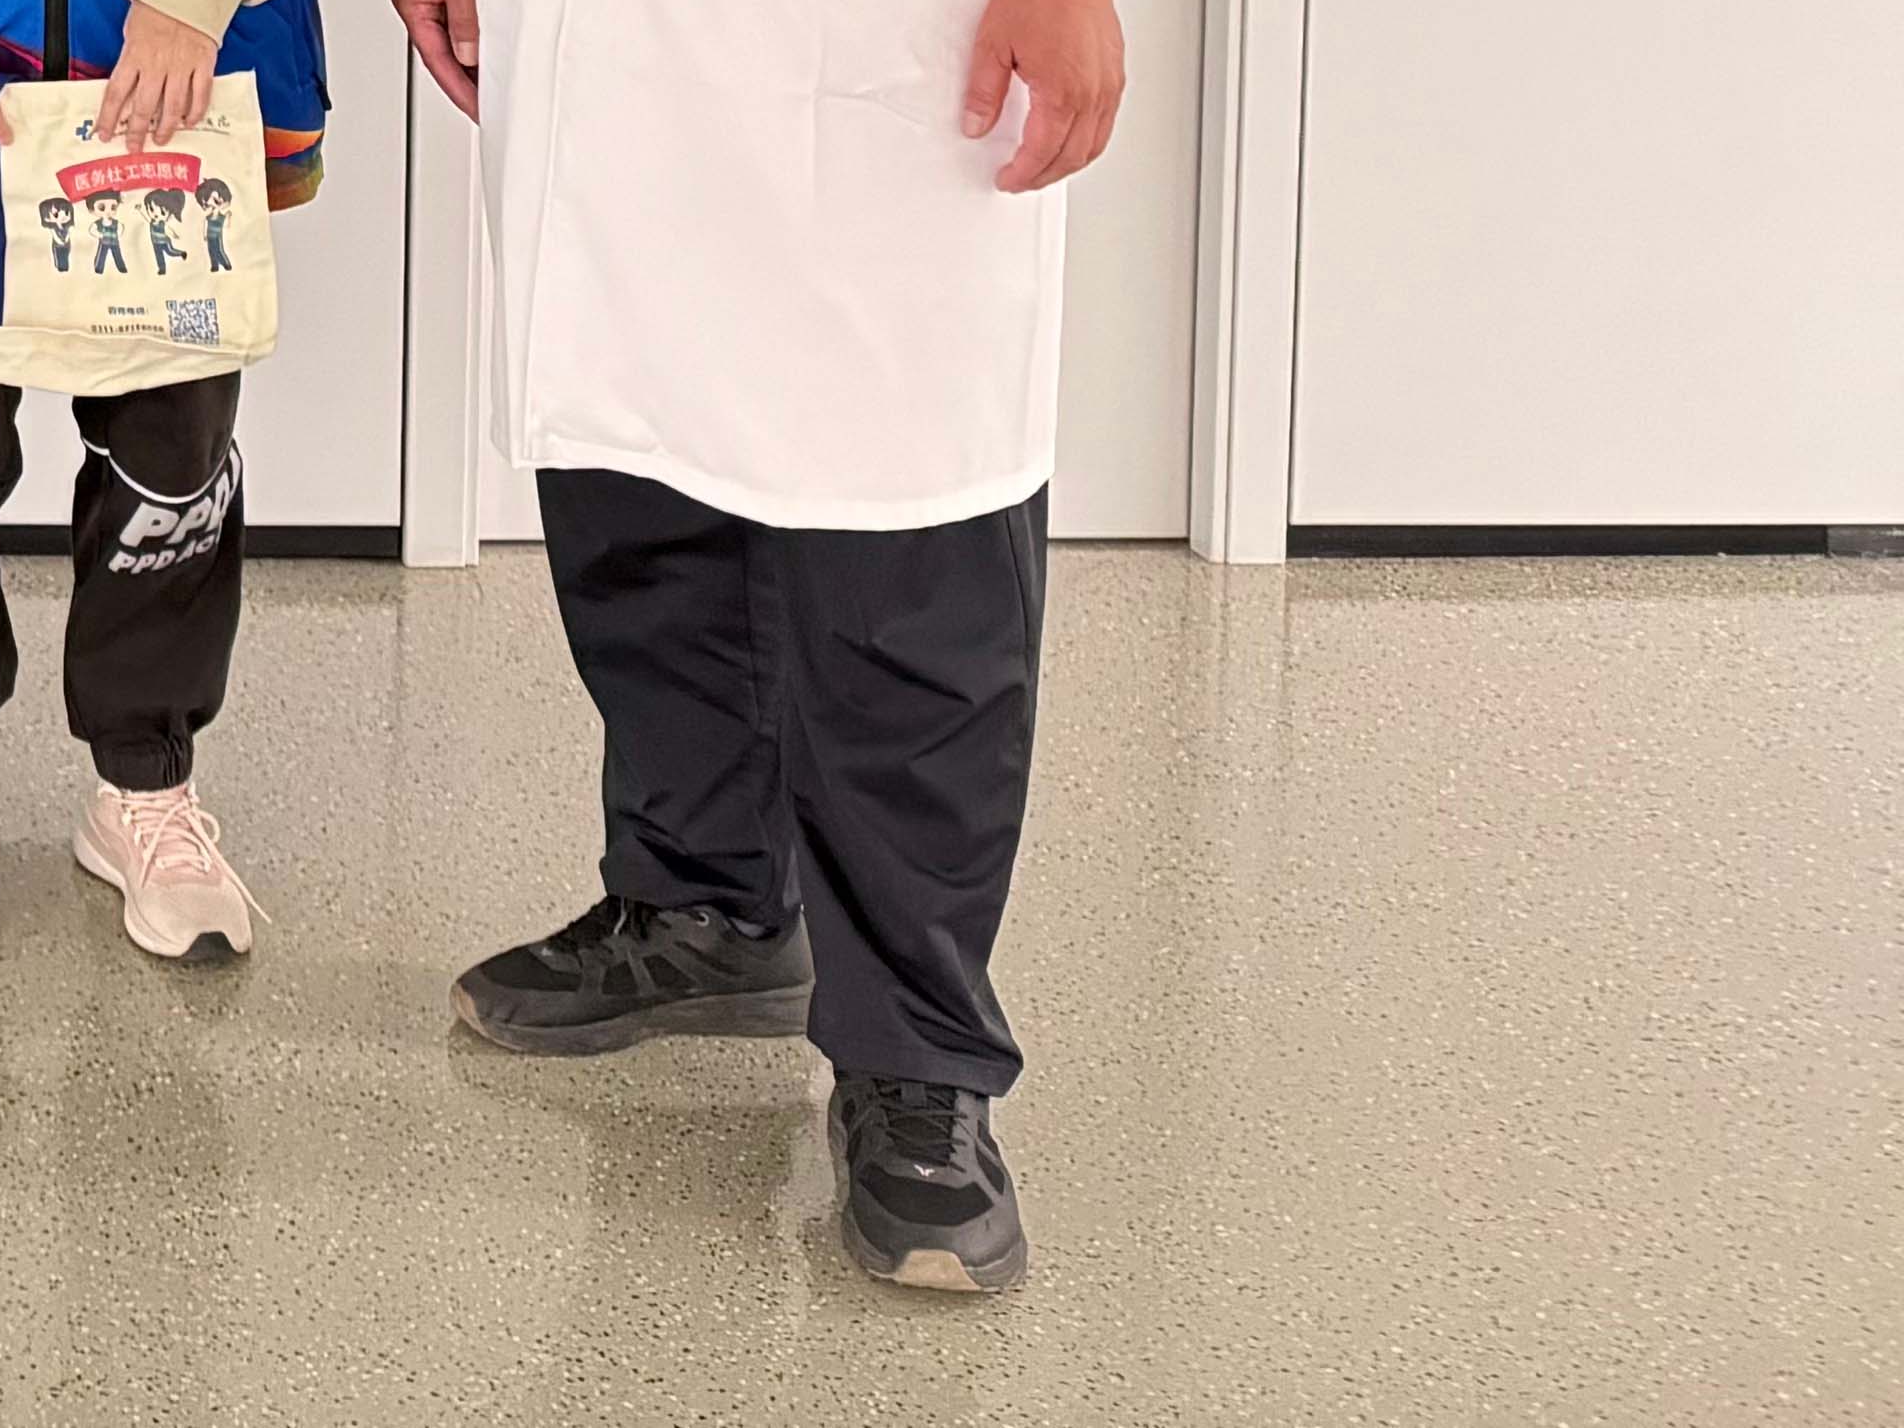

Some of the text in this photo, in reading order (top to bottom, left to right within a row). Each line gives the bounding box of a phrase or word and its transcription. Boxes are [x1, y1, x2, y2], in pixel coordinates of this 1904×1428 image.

[74, 161, 190, 192] 医务社工志愿者
